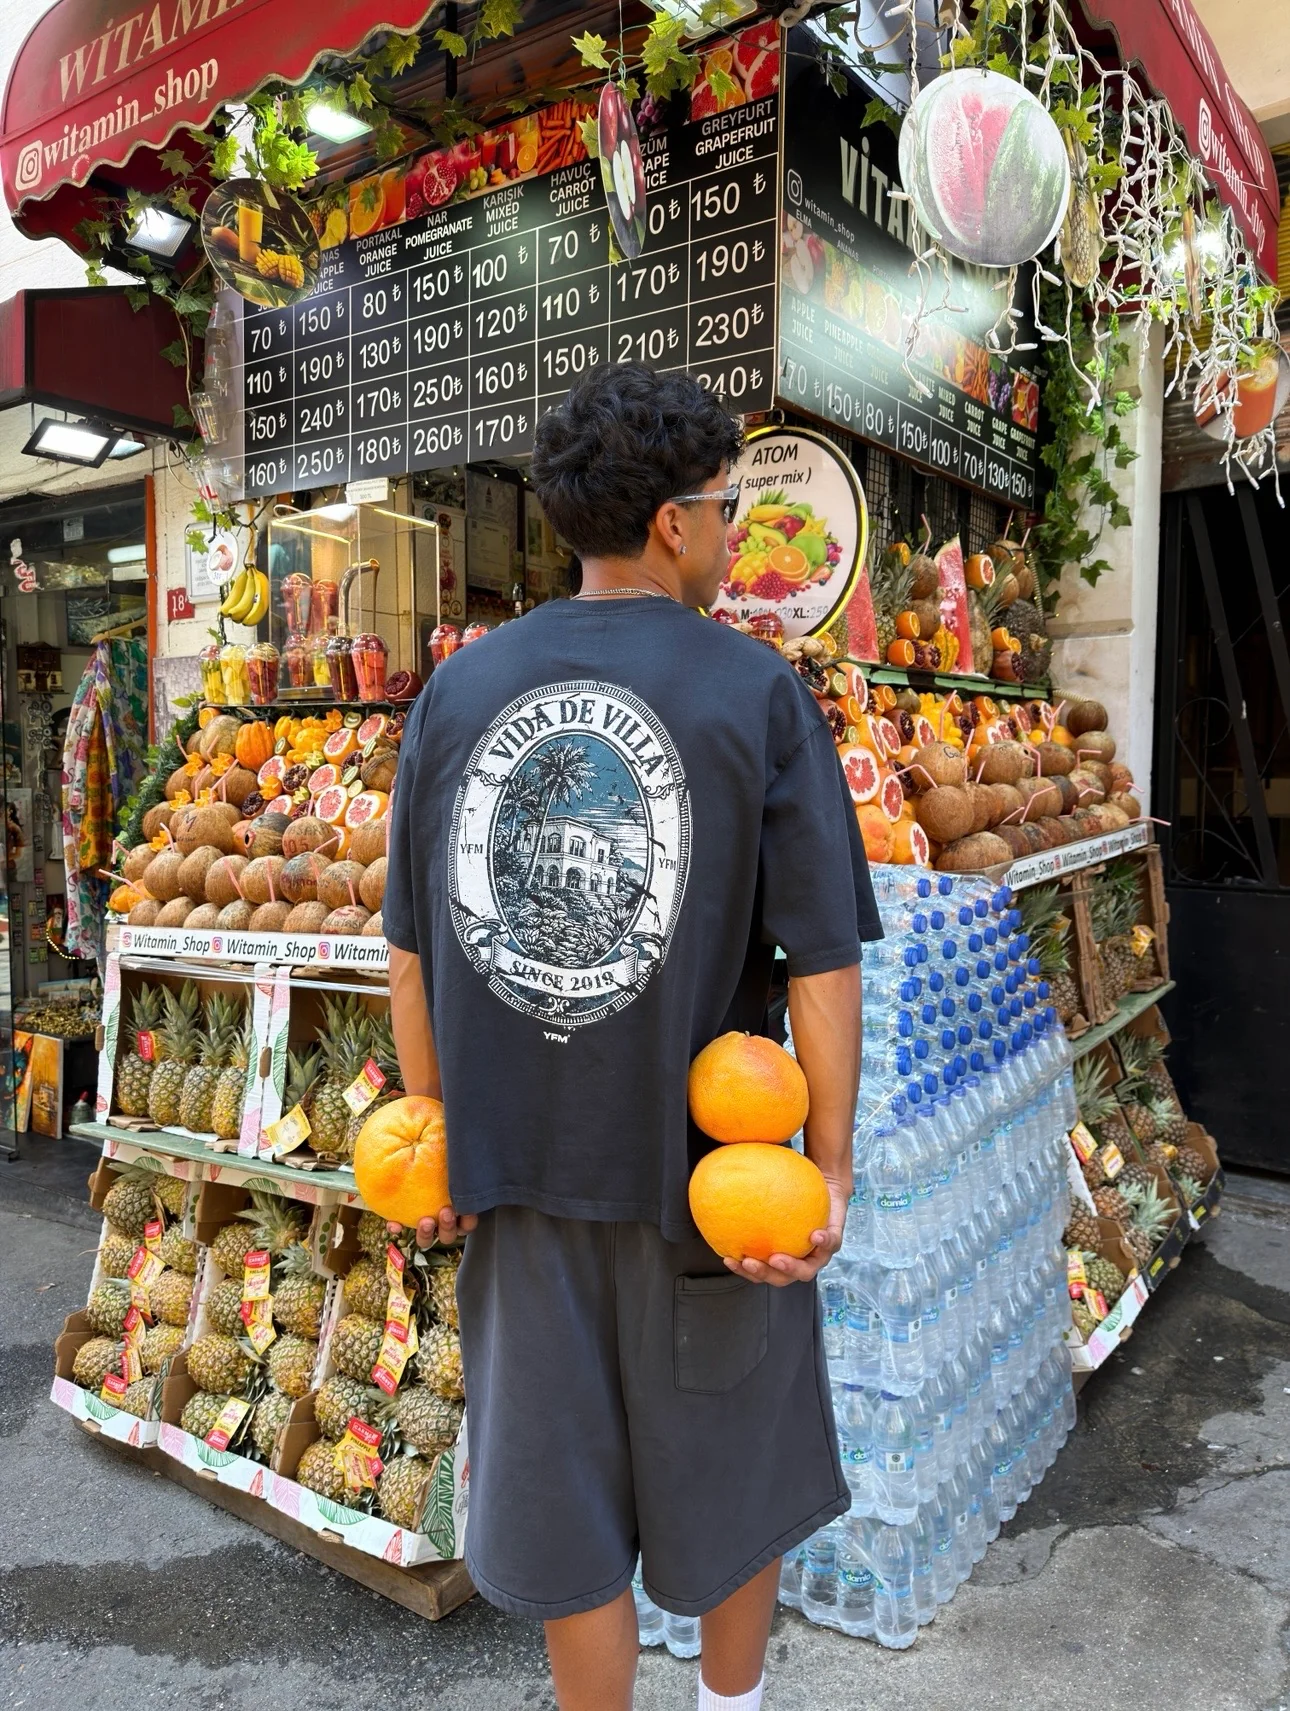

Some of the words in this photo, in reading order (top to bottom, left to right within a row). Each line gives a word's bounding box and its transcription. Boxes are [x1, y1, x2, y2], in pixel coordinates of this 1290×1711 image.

[59, 0, 246, 102] WİTAM
[42, 57, 219, 168] witamin_shop
[701, 99, 774, 136] GREYFURT
[638, 136, 668, 155] ZÜM
[695, 117, 776, 156] GRAPEFRUIT
[715, 145, 754, 170] JUICE
[551, 162, 591, 187] HAVUÇ
[483, 185, 524, 210] KARIŞIK
[549, 176, 596, 203] CARROT
[486, 201, 520, 223] MIXED
[555, 194, 590, 217] JUICE
[427, 210, 448, 228] NAR
[487, 216, 518, 237] JUICE
[795, 208, 812, 229] ELMA
[804, 197, 855, 243] witamin_shop
[356, 228, 402, 251] PORTAKAL
[405, 216, 473, 250] POMEGRANATE
[359, 244, 398, 265] ORANGE
[423, 240, 453, 260] JUICE
[837, 240, 859, 262] ANANAS
[365, 261, 392, 277] JUICE
[791, 296, 816, 324] APPLE
[791, 319, 814, 344] JUICE
[824, 320, 863, 354] PINEAPPLE
[938, 403, 954, 423] JUICE
[964, 401, 985, 422] CARROT
[966, 419, 981, 437] JUICE
[991, 416, 1008, 435] GRAPE
[992, 433, 1006, 450] JUICE
[752, 443, 799, 467] ATOM
[488, 703, 555, 762] VIDA
[558, 699, 596, 725] DE
[601, 702, 669, 777] VILLA
[460, 843, 484, 855] YFM
[658, 857, 677, 871] YFM
[134, 933, 211, 955] Witamin_Shop
[226, 937, 317, 962] Witamin_Shop
[509, 960, 564, 991] SINCE
[570, 971, 614, 991] 2019
